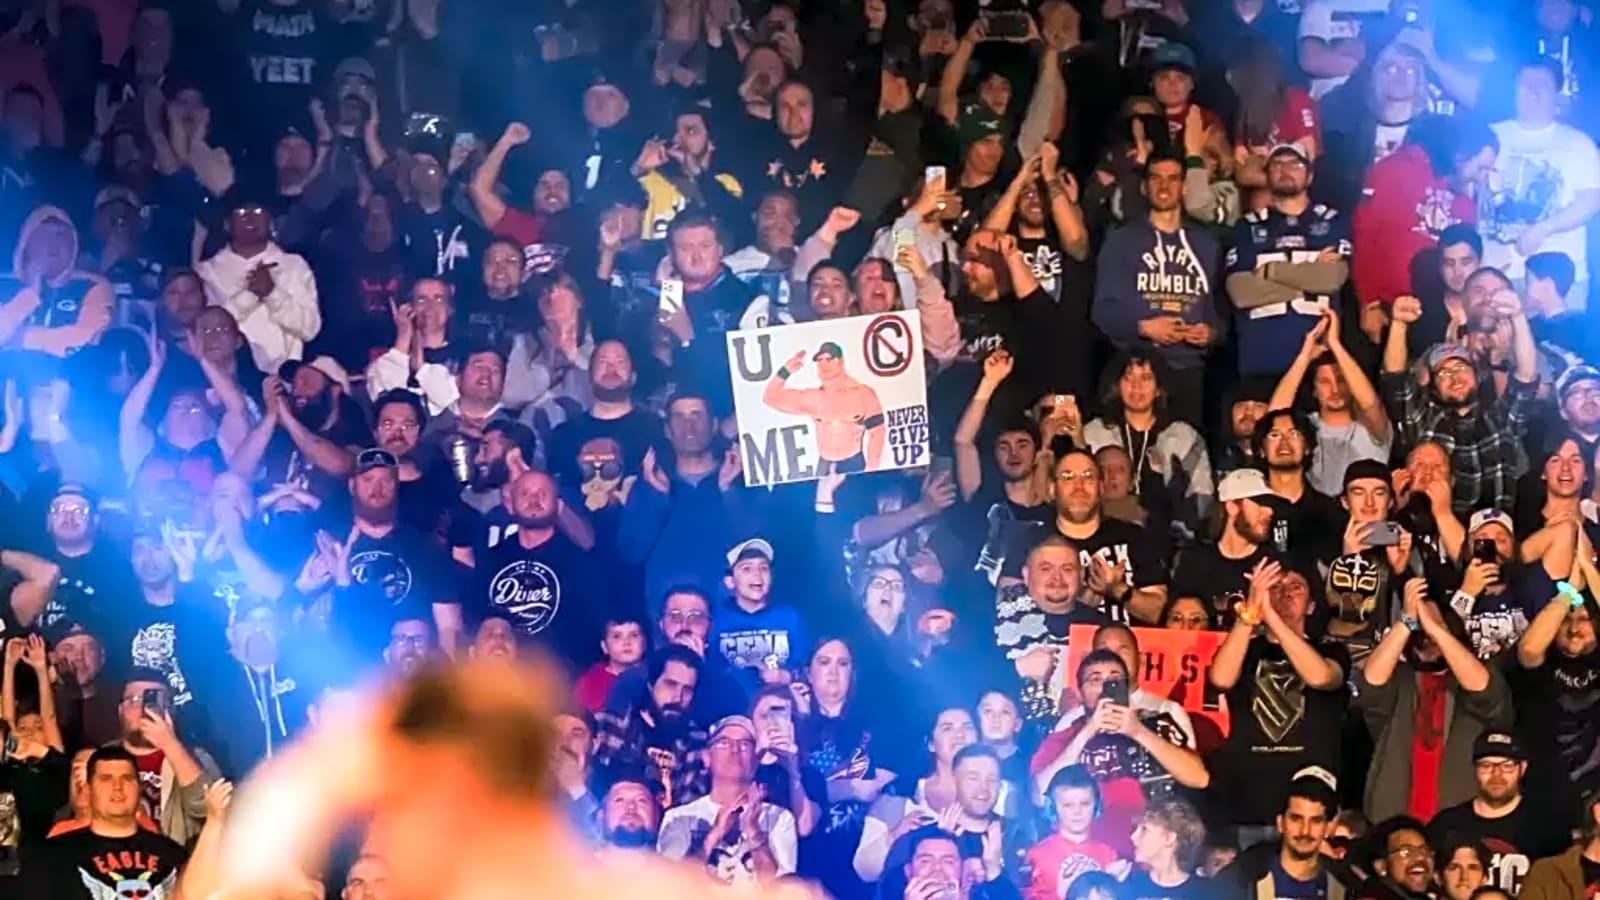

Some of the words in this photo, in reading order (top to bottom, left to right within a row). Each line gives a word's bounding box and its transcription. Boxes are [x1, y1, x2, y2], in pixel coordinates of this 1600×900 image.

[250, 55, 317, 84] YEET
[1137, 272, 1205, 295] RUMBLE
[732, 334, 772, 382] U
[871, 321, 906, 370] C
[886, 404, 926, 427] NEVER
[888, 423, 929, 446] GIVE
[742, 423, 814, 486] ME
[892, 444, 925, 466] UP
[495, 577, 553, 604] Diner
[92, 850, 160, 874] EAGLE
